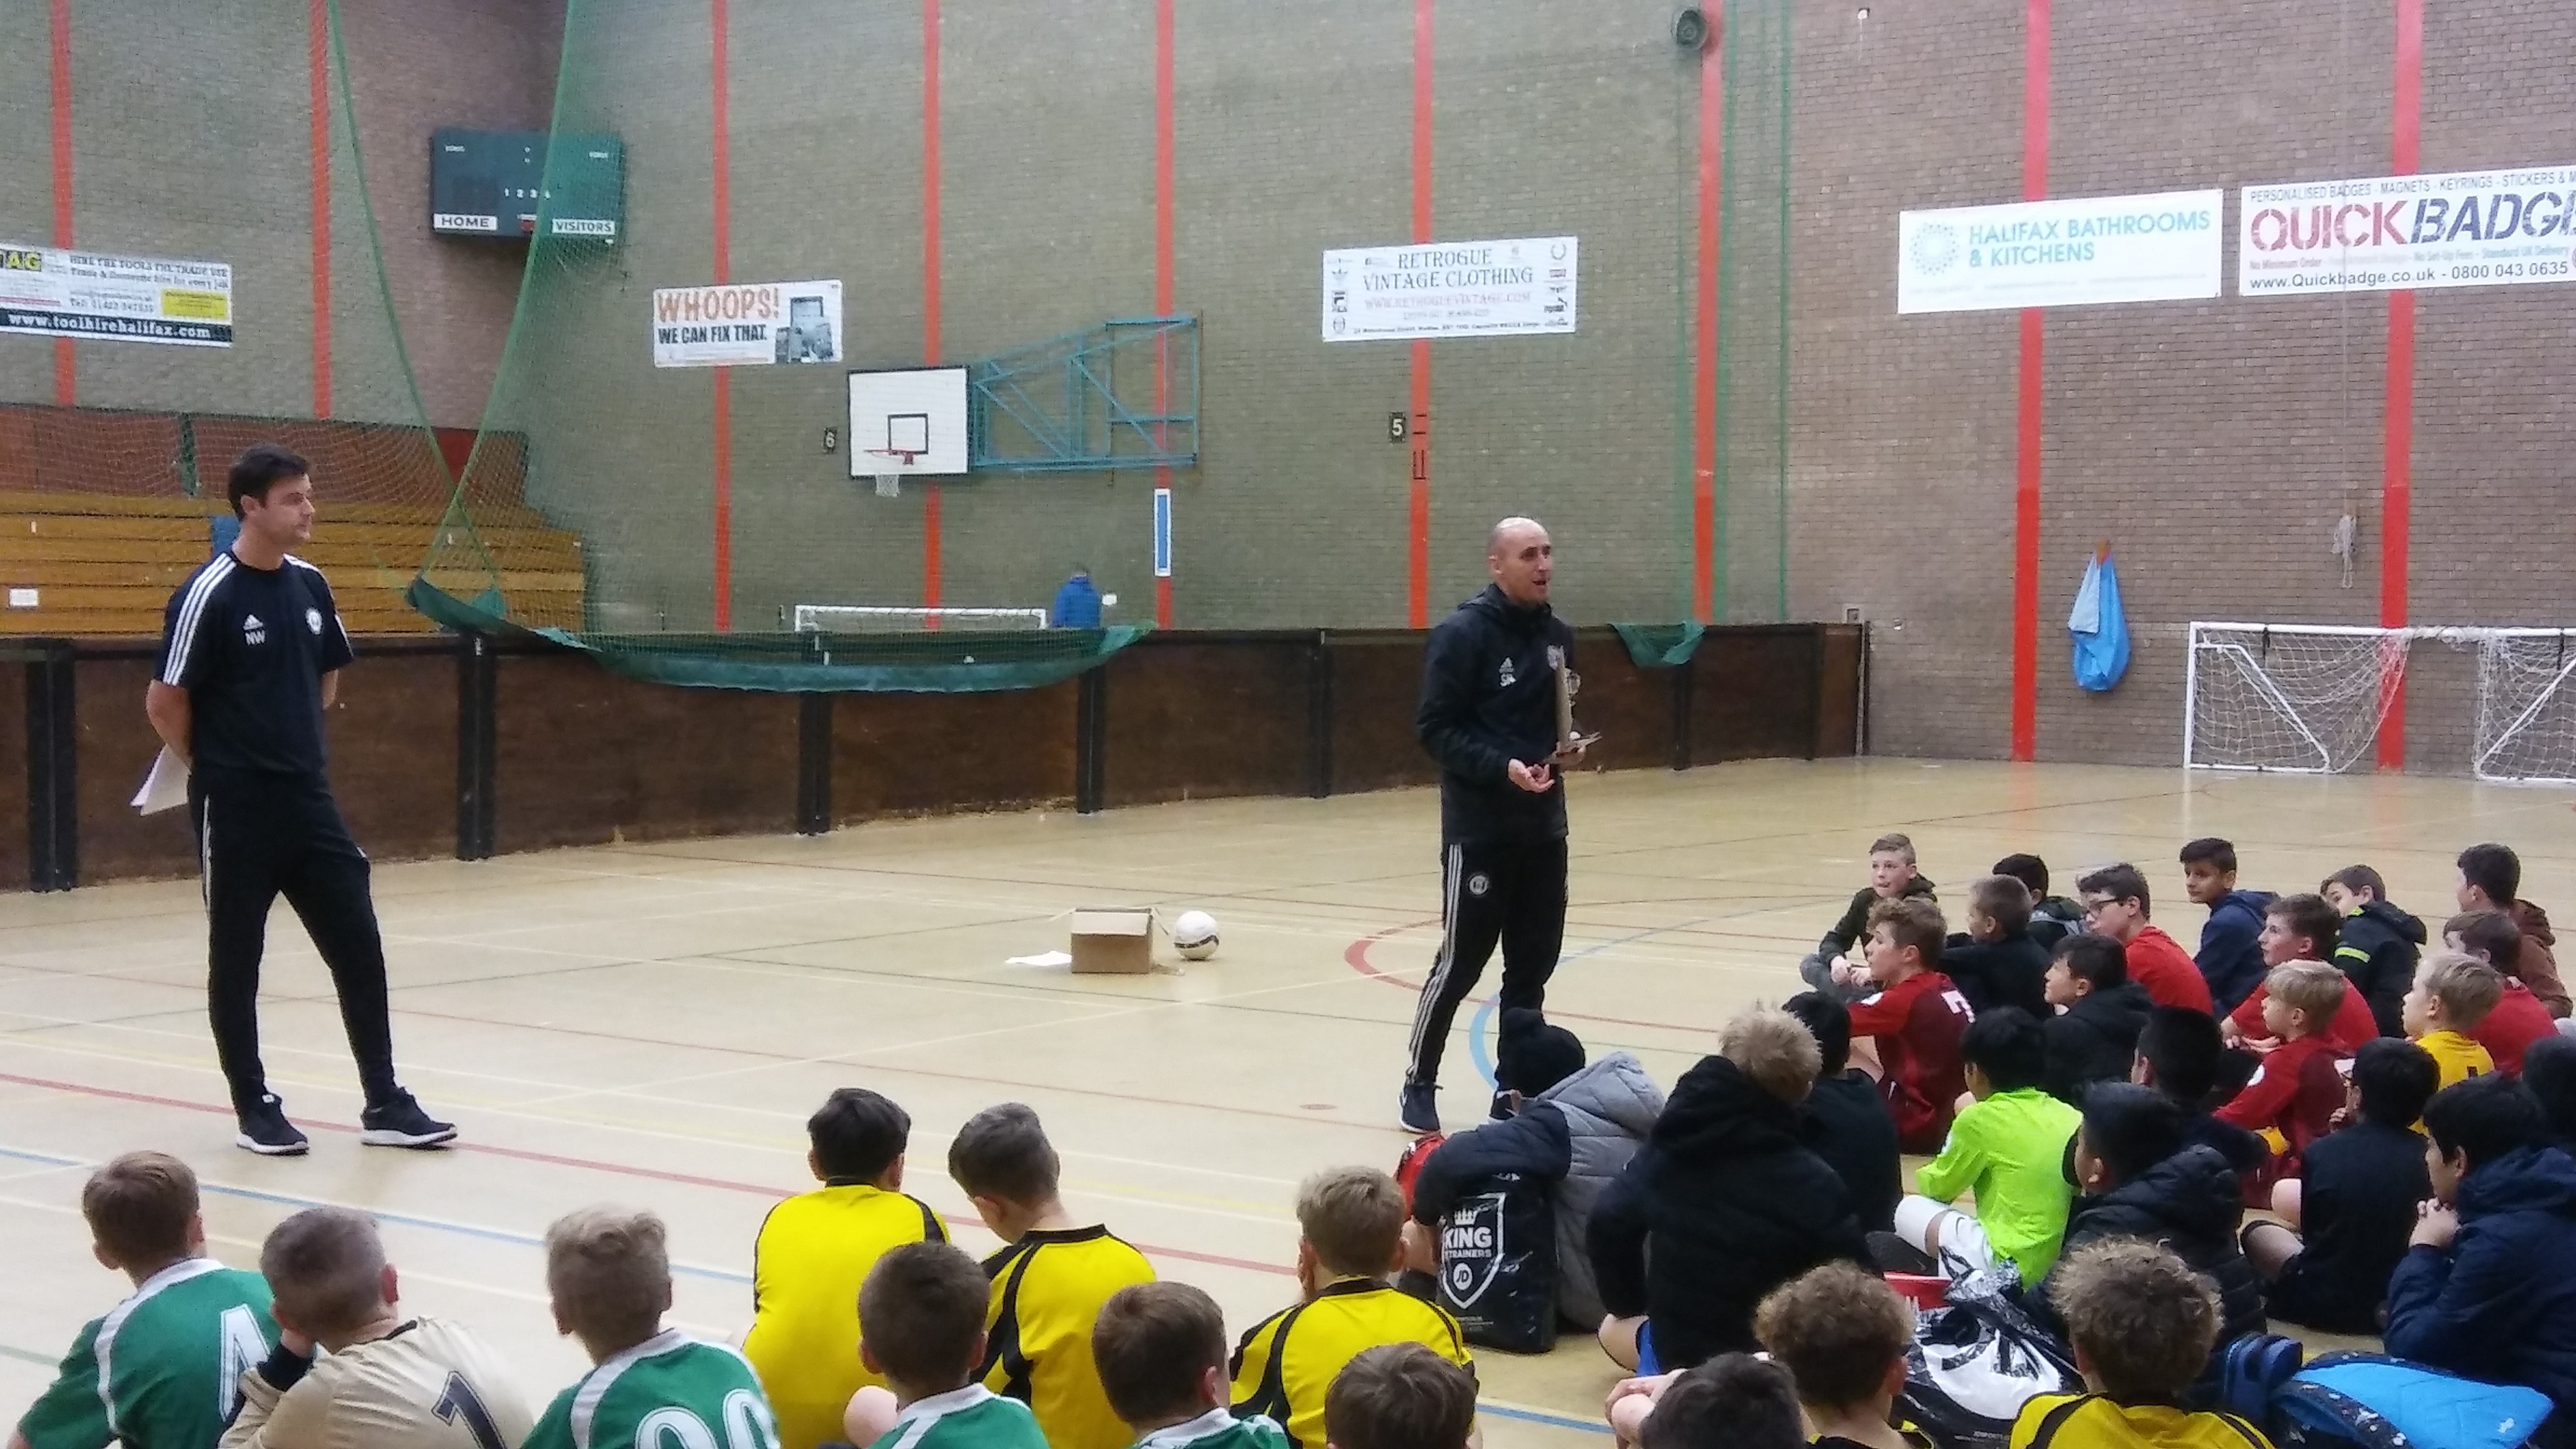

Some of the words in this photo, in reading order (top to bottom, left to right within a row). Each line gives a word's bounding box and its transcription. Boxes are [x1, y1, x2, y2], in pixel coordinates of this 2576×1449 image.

[505, 188, 510, 198] 1
[516, 188, 524, 198] 2
[530, 189, 537, 199] 3
[2251, 186, 2326, 202] PERSONALISED
[2330, 183, 2371, 198] BADGES
[2381, 179, 2429, 195] MAGNETS
[2440, 176, 2492, 191] KEYRINGS
[2502, 172, 2554, 187] STICKERS
[2559, 172, 2565, 183] &
[442, 216, 490, 228] HOME
[556, 220, 612, 233] VISITORS
[1970, 221, 2060, 245] HALIFAX
[2068, 209, 2211, 238] BATHROOMS
[1398, 248, 1492, 269] RETROGUE
[1970, 250, 1982, 267] &
[1991, 242, 2095, 266] KITCHENS
[1363, 271, 1440, 290] VINTAGE
[1446, 267, 1533, 287] CLOTHING
[2250, 268, 2435, 289] www.Quickbadge.co.uk
[2452, 265, 2489, 279] 0800
[2496, 264, 2523, 277] 043
[2530, 261, 2568, 276] 0635
[659, 287, 779, 323] WHOOPS!
[7, 315, 211, 338] www.toolhirehalifax.com
[658, 328, 678, 344] WE
[682, 326, 707, 343] CAN
[712, 324, 730, 342] FIX
[1391, 418, 1403, 436] 5
[825, 432, 835, 448] 6
[245, 629, 266, 645] NW
[1446, 1227, 1492, 1249] KING
[1456, 1269, 1469, 1283] JD
